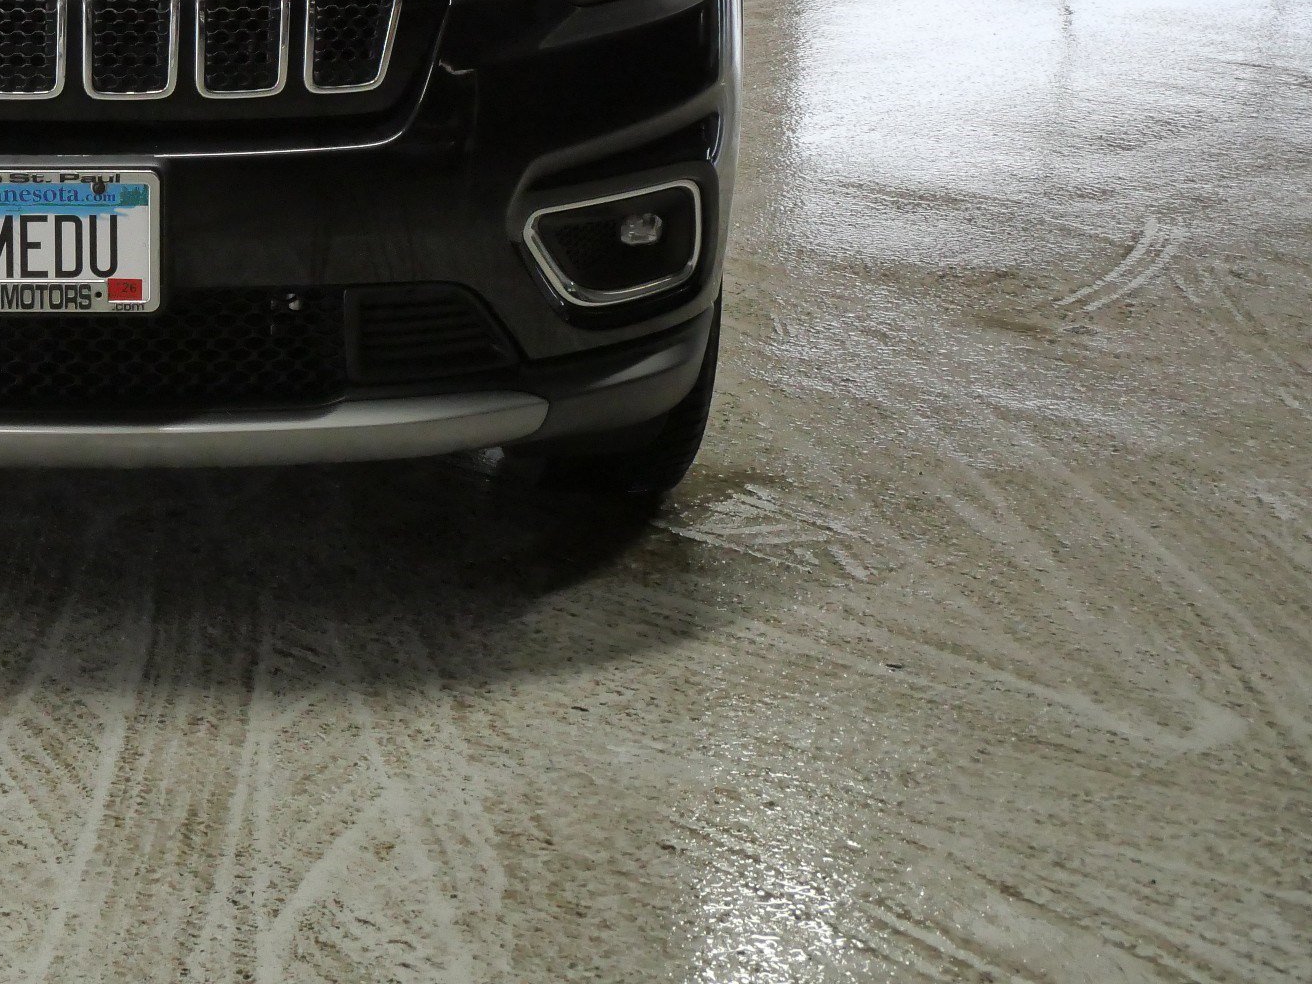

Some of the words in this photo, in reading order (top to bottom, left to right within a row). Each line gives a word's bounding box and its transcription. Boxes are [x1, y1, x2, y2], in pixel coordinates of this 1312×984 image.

[9, 173, 52, 183] St.
[60, 173, 121, 183] Paul
[111, 302, 145, 311] .com
